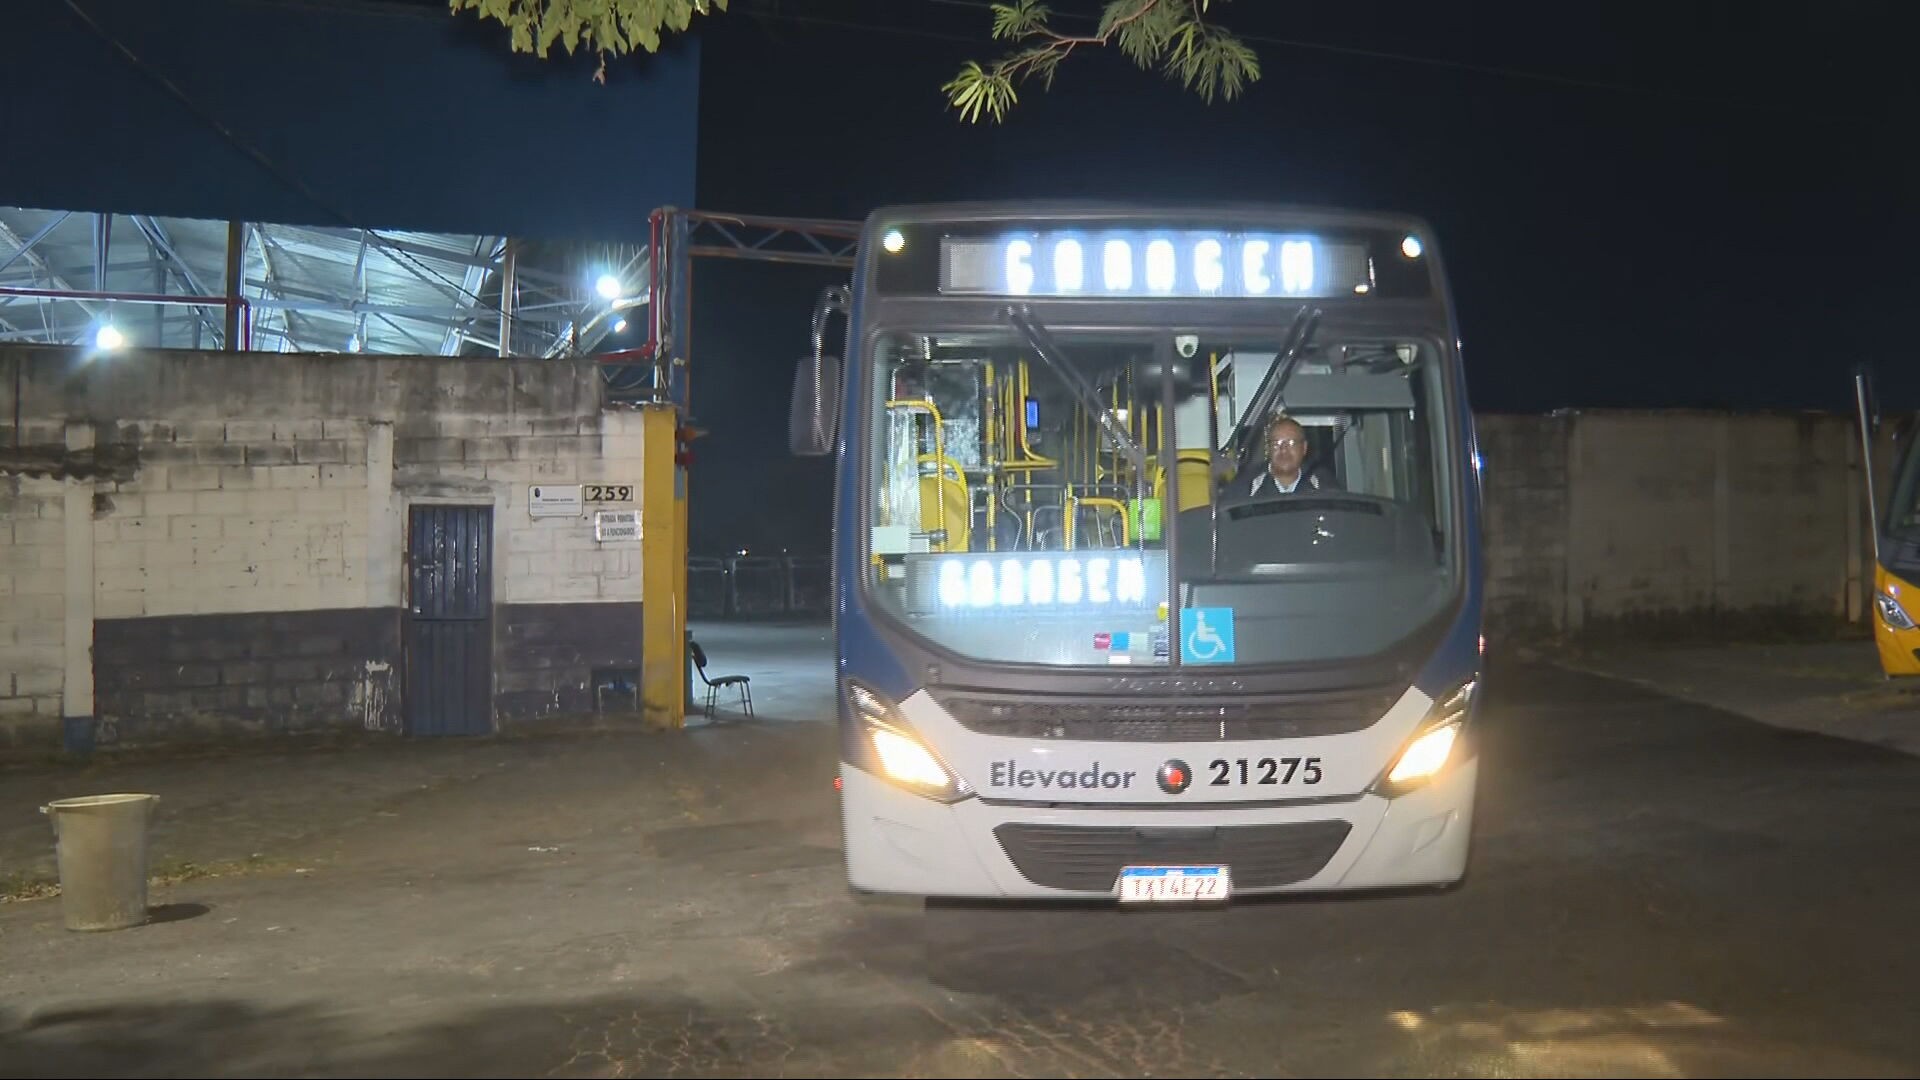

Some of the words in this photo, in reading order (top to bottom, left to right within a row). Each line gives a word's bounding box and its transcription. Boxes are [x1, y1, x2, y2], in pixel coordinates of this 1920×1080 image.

[591, 486, 630, 501] 259
[989, 760, 1137, 789] Elevador
[1208, 757, 1323, 785] 21275
